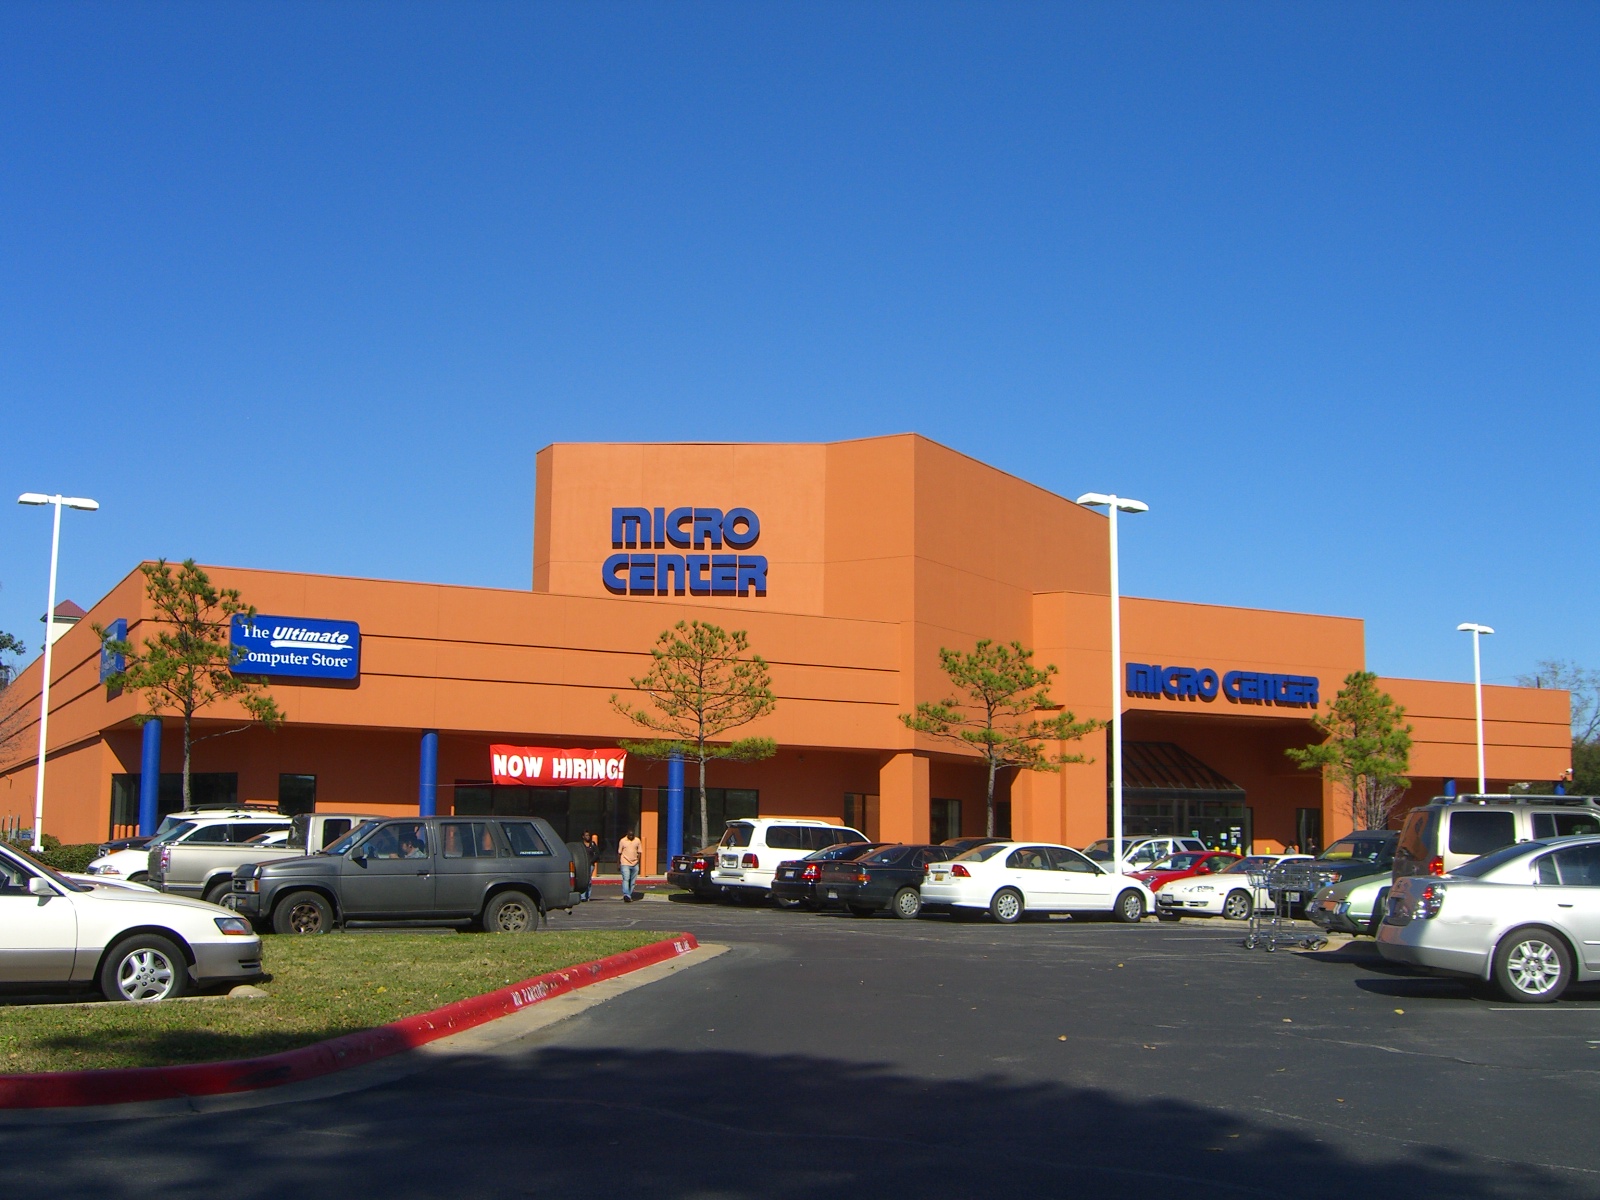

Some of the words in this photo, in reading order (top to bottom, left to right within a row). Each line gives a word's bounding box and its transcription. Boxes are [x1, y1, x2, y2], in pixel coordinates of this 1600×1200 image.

[612, 507, 760, 549] MICRO
[602, 553, 768, 597] CENTER
[241, 624, 269, 639] The
[272, 626, 349, 644] Ultimate
[1126, 662, 1219, 701] MICRO
[1222, 670, 1319, 707] CENTER
[493, 754, 543, 778] NOW
[552, 753, 626, 780] HIRING!
